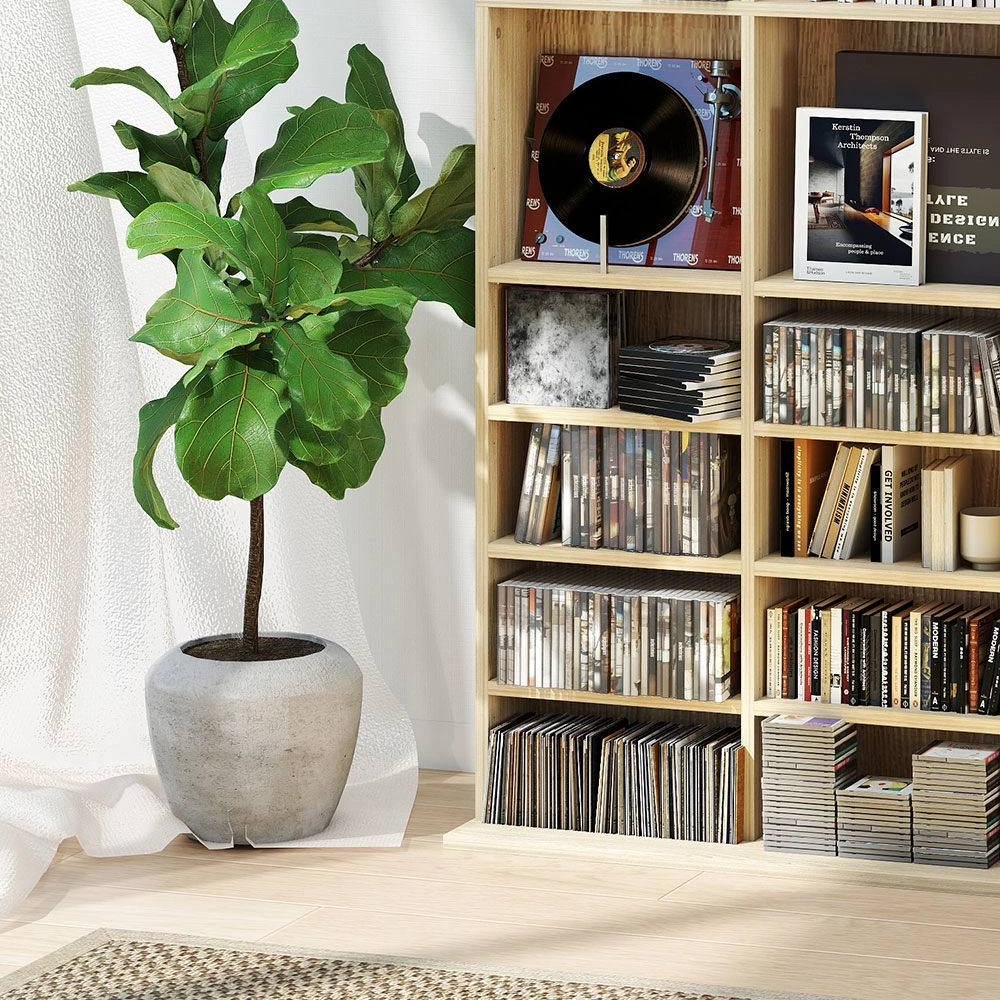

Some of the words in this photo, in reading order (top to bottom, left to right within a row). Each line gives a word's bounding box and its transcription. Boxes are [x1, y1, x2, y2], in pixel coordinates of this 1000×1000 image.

[540, 55, 555, 68] RENS
[582, 56, 608, 69] THORENS
[636, 58, 662, 71] THORENS
[536, 102, 550, 115] RENS
[832, 123, 861, 132] Kerstin
[849, 132, 890, 142] Thompson
[837, 141, 878, 150] Architects
[526, 198, 541, 210] RENS
[521, 246, 536, 259] RENS
[835, 242, 873, 250] Encompassing
[564, 248, 590, 261] THORENS
[618, 249, 645, 263] THORENS
[672, 252, 699, 266] THORENS
[884, 470, 893, 489] GET
[833, 483, 851, 525] MINIMALISM
[884, 492, 893, 543] INVOLVED
[988, 626, 999, 664] MODERN
